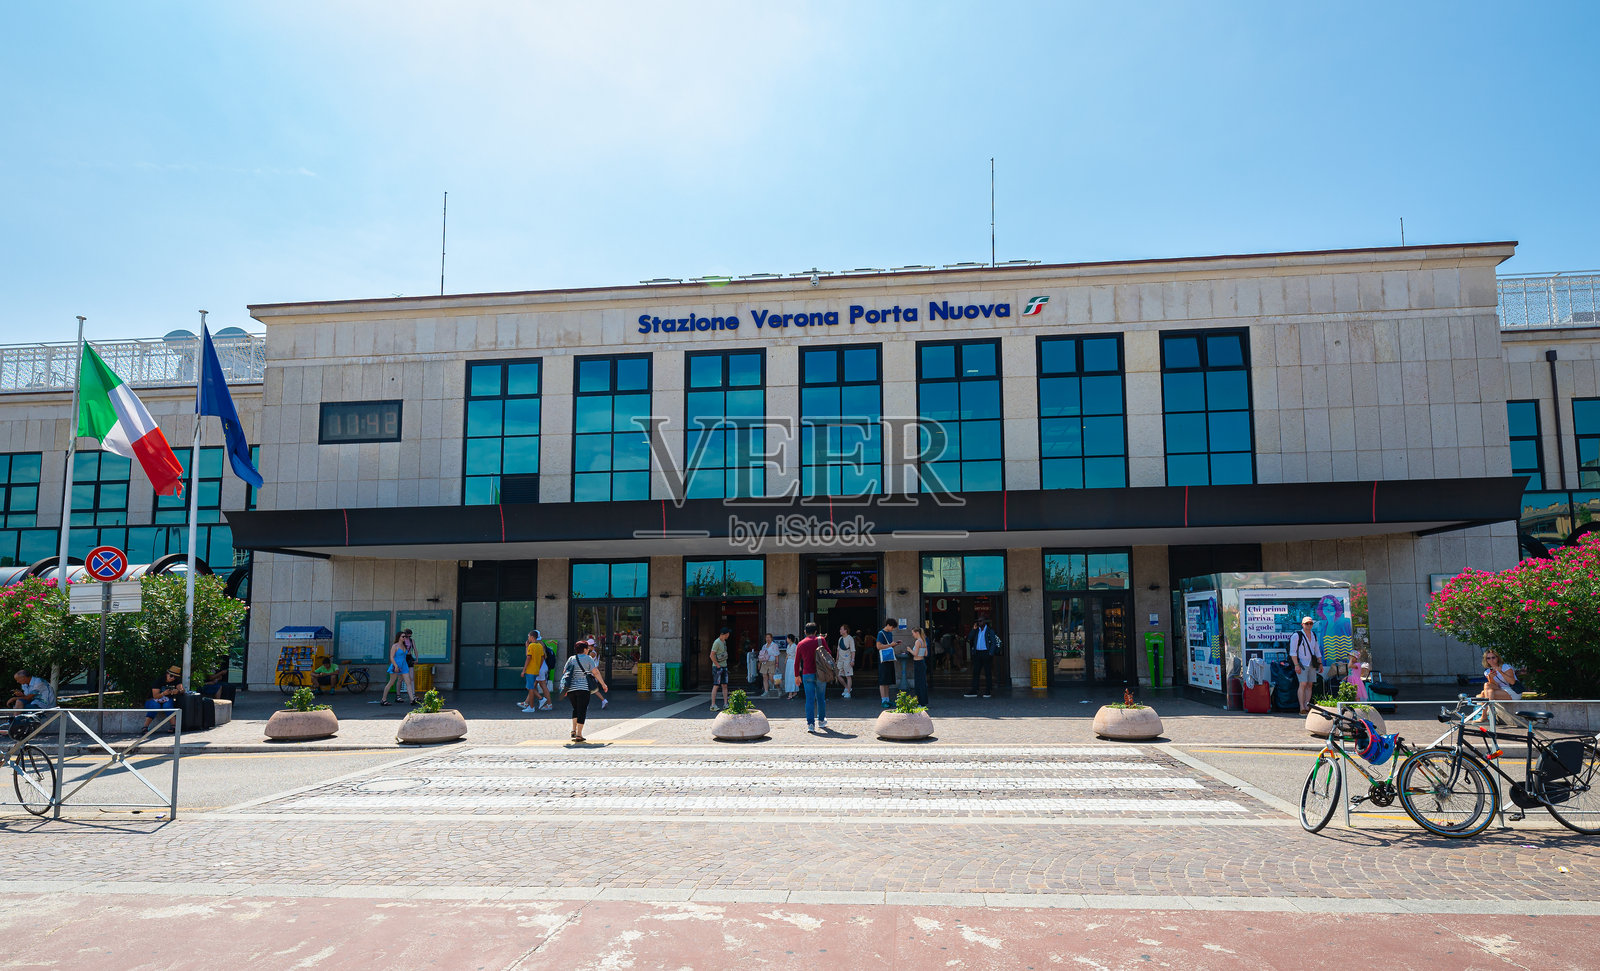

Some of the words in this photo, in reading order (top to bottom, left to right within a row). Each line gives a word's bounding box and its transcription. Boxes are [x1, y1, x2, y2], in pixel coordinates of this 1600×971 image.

[637, 312, 740, 334] Stazione
[751, 309, 839, 329] Verona
[849, 305, 919, 324] Porta
[928, 301, 1011, 321] Nuova
[1262, 605, 1286, 614] prima
[1257, 633, 1292, 641] shopping
